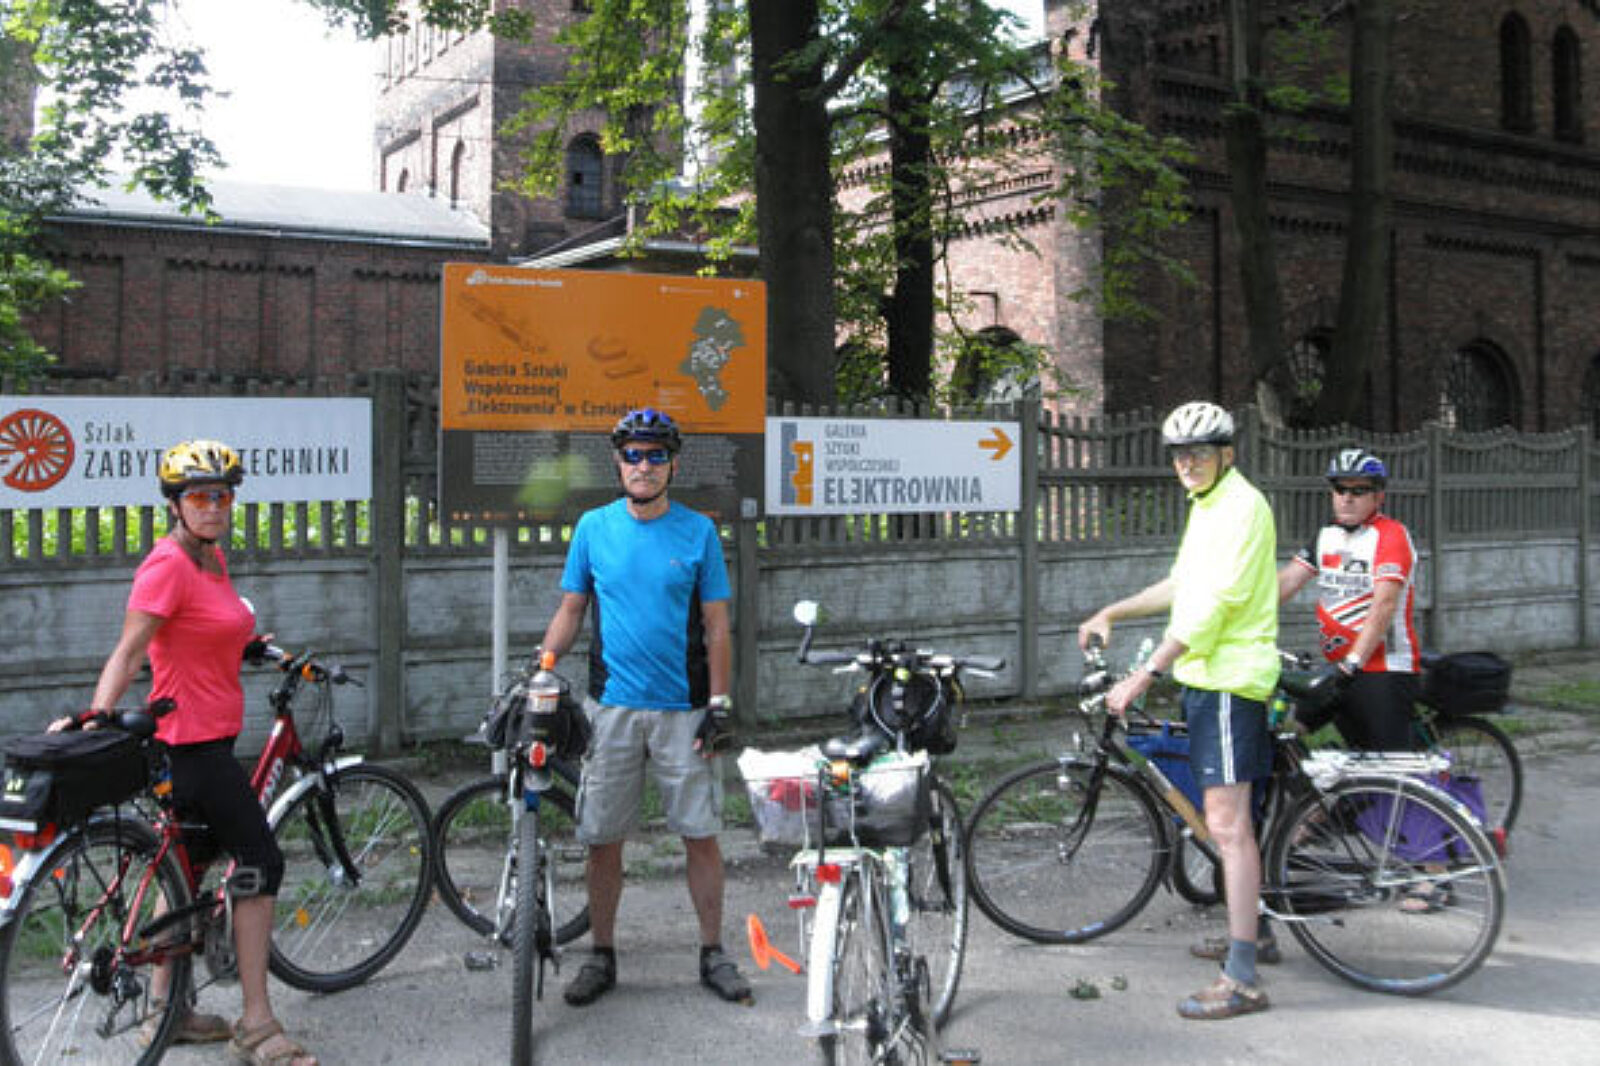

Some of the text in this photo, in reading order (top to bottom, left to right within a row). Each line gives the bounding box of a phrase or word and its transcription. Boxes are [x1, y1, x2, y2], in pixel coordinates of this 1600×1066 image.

[464, 360, 568, 378] Galeria Sztuki
[84, 422, 135, 444] Szlak
[824, 423, 867, 439] GALERIA
[824, 441, 861, 455] SZTUKI
[84, 445, 350, 478] ZABYT TECHNIKI
